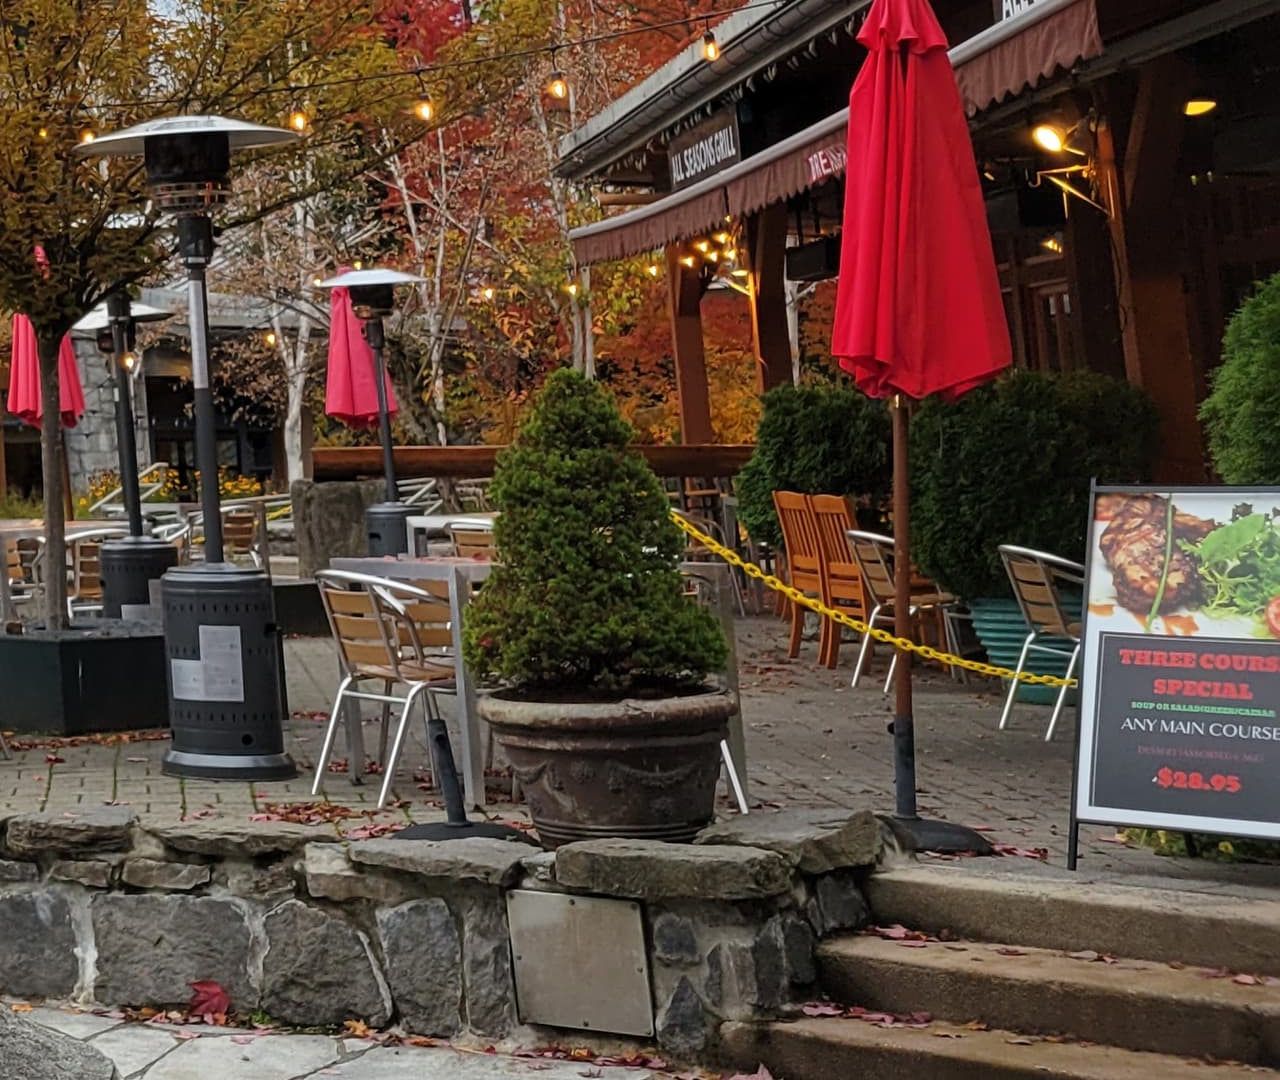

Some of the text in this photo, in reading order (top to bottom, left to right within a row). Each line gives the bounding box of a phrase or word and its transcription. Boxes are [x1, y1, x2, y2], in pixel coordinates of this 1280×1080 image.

[671, 125, 736, 185] ALL SEASONS GRILL
[1119, 648, 1280, 673] THREE COURS
[1153, 678, 1254, 700] SPECIAL
[1131, 701, 1155, 711] SOUP
[1156, 703, 1170, 711] OR
[1121, 717, 1280, 741] ANY MAIN COURSE
[1157, 766, 1242, 793] $28.95
